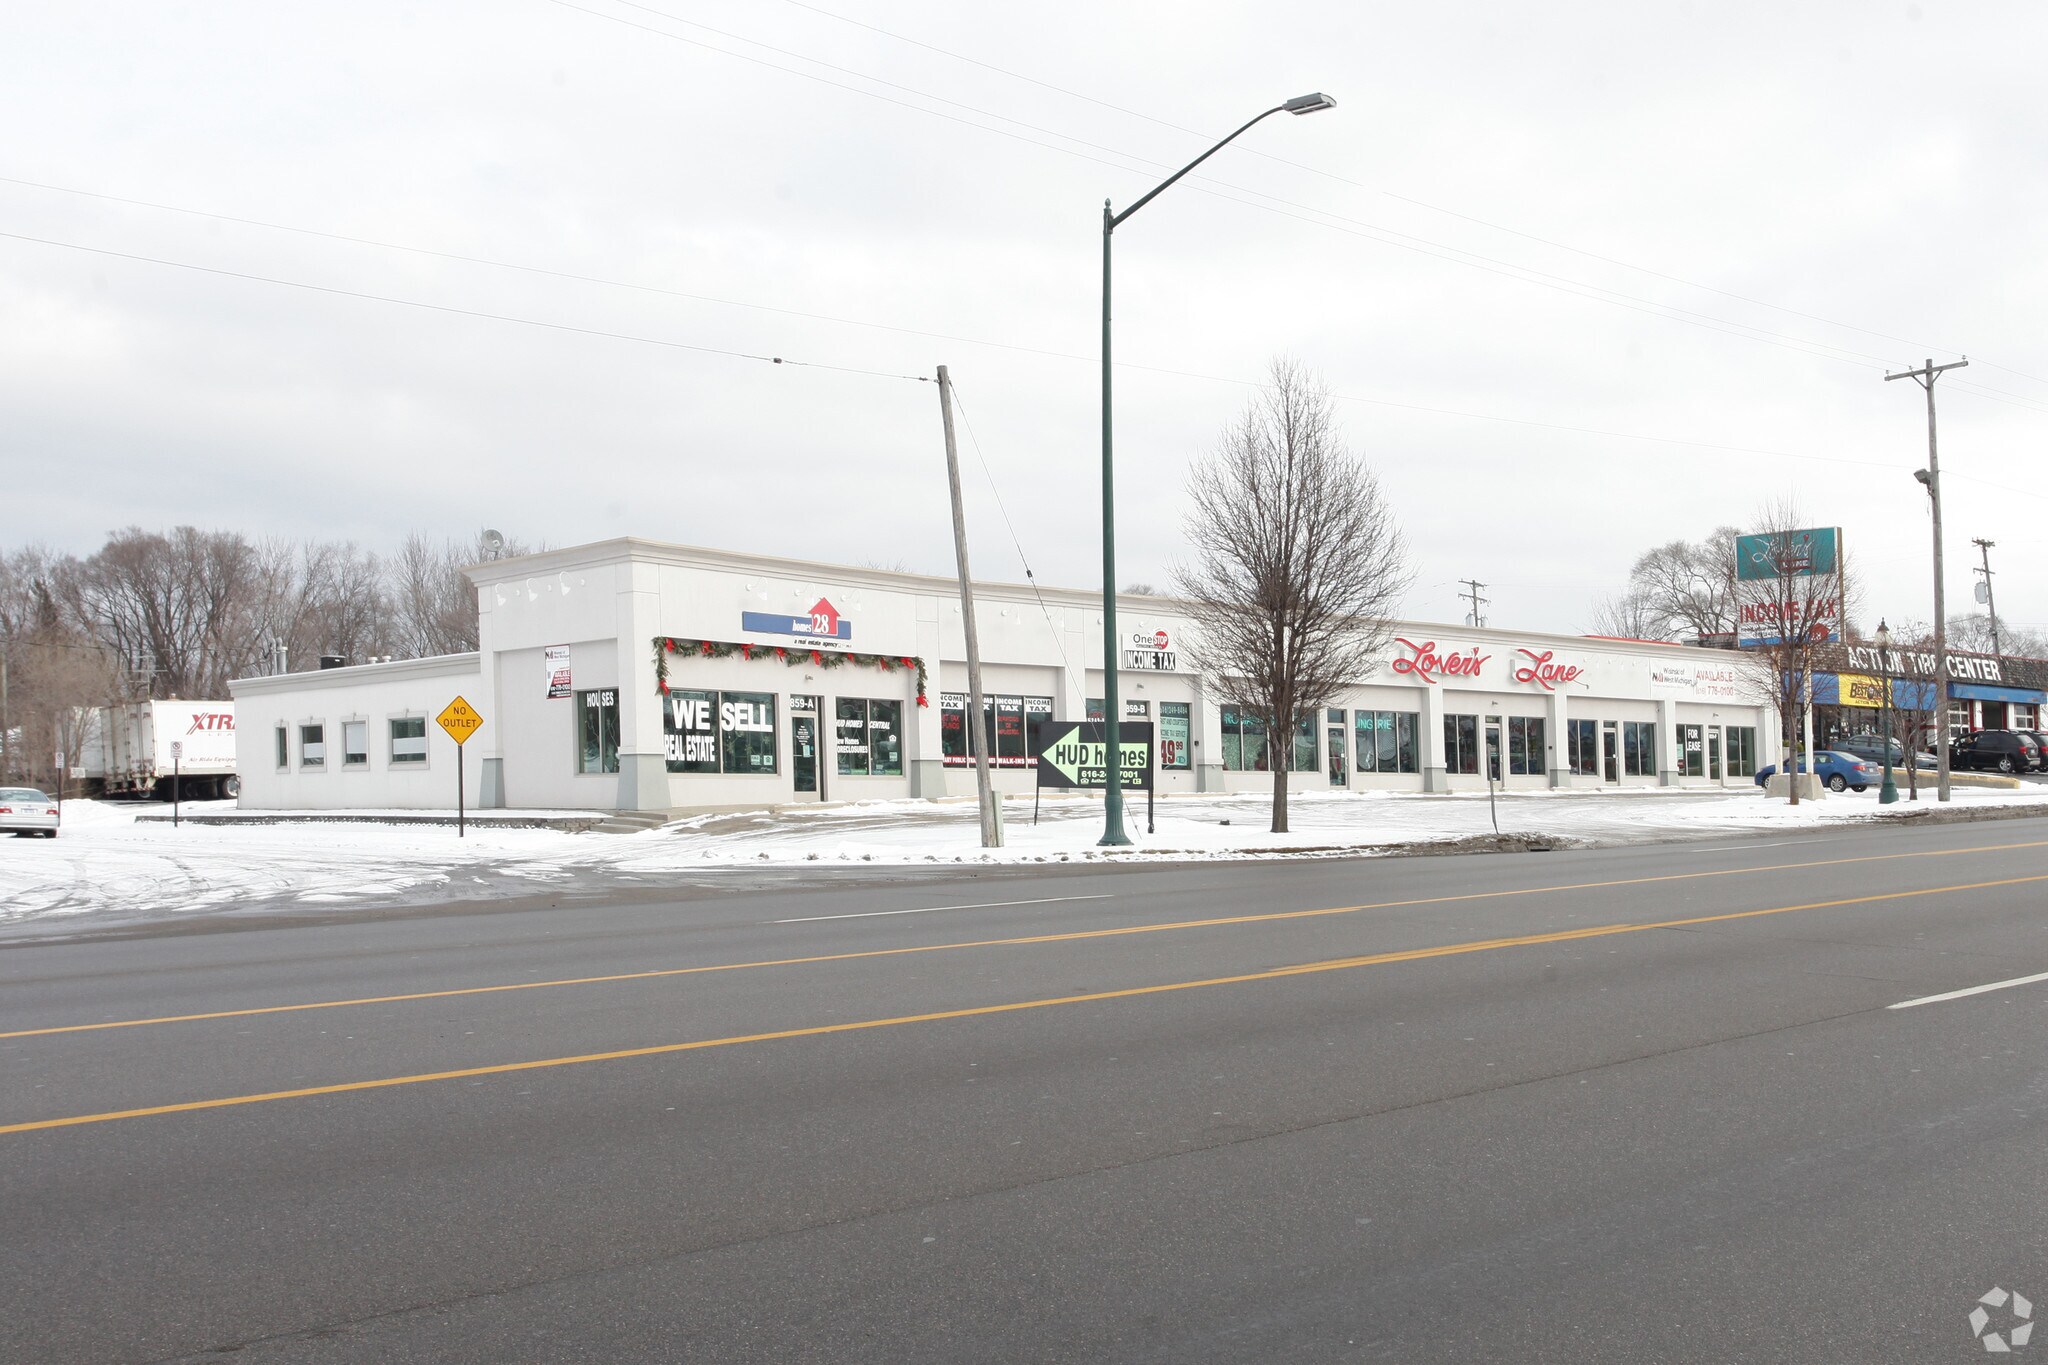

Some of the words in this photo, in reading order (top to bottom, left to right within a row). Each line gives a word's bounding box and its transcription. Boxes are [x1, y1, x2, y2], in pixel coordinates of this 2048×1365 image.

[792, 620, 812, 633] homes
[813, 613, 830, 634] 28
[808, 640, 823, 648] estate
[1133, 633, 1153, 644] One
[1153, 635, 1168, 646] STOP
[1124, 651, 1156, 669] INCOME
[1157, 653, 1175, 670] TAX
[1392, 637, 1491, 685] Lover's
[1515, 648, 1584, 691] Lane
[1944, 655, 2002, 682] CENTER
[940, 694, 964, 702] NCOME
[996, 697, 1021, 706] INCOME
[453, 706, 467, 716] NO
[999, 704, 1019, 712] TAX
[671, 699, 712, 731] WE
[721, 702, 774, 734] SELL
[443, 718, 477, 728] OUTLET
[869, 720, 891, 730] CENTRAL
[1687, 728, 1699, 739] FOR
[664, 734, 686, 762] REAL
[686, 735, 716, 762] ESTATE
[837, 745, 869, 754] ORECLOSURES
[1055, 744, 1089, 766] HUD
[1094, 744, 1145, 767] hmes
